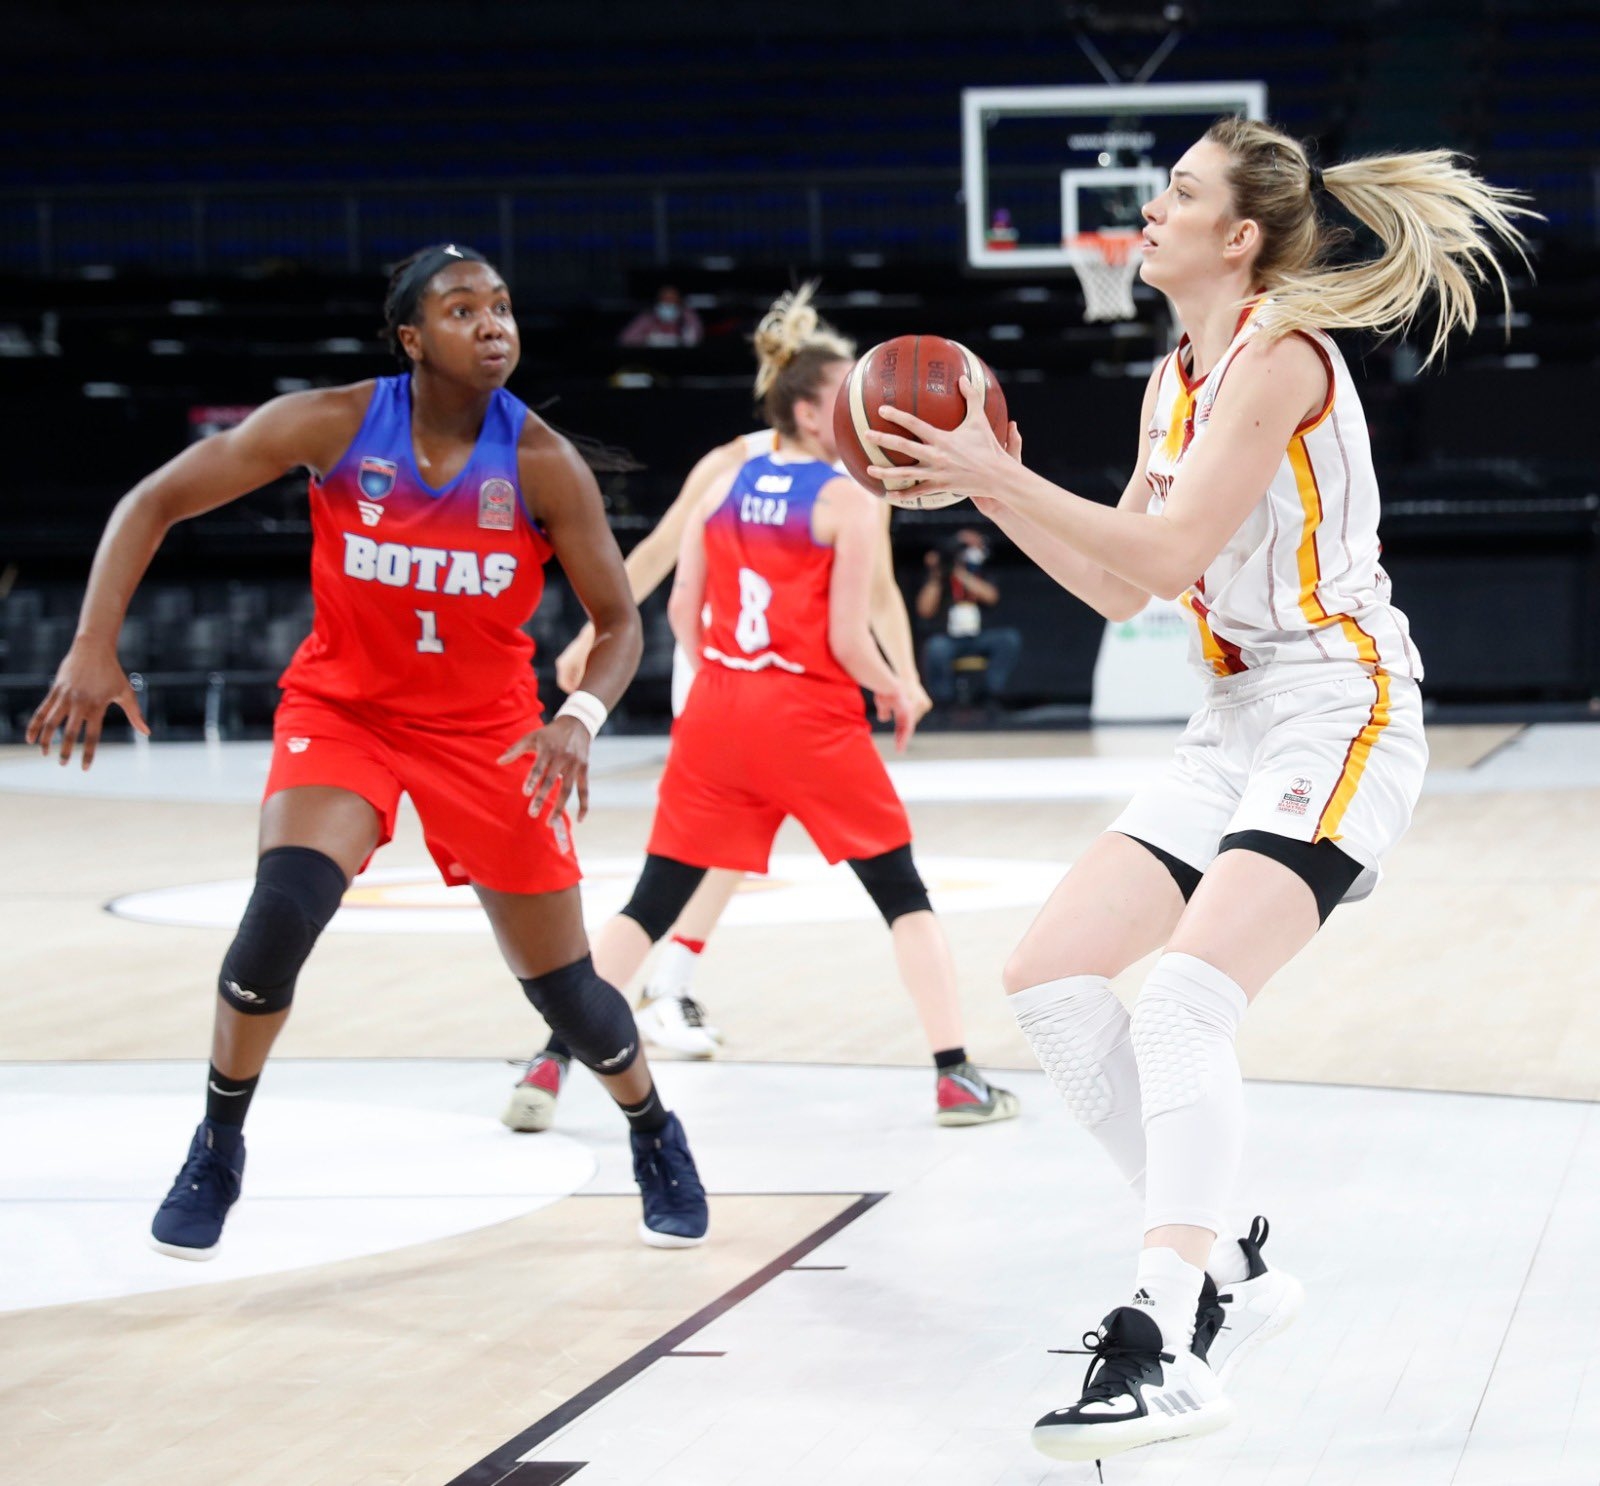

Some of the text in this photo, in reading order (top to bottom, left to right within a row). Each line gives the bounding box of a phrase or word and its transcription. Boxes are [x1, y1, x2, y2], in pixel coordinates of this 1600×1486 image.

[414, 608, 445, 654] 1
[734, 566, 773, 654] 8
[1131, 1297, 1156, 1307] idas
